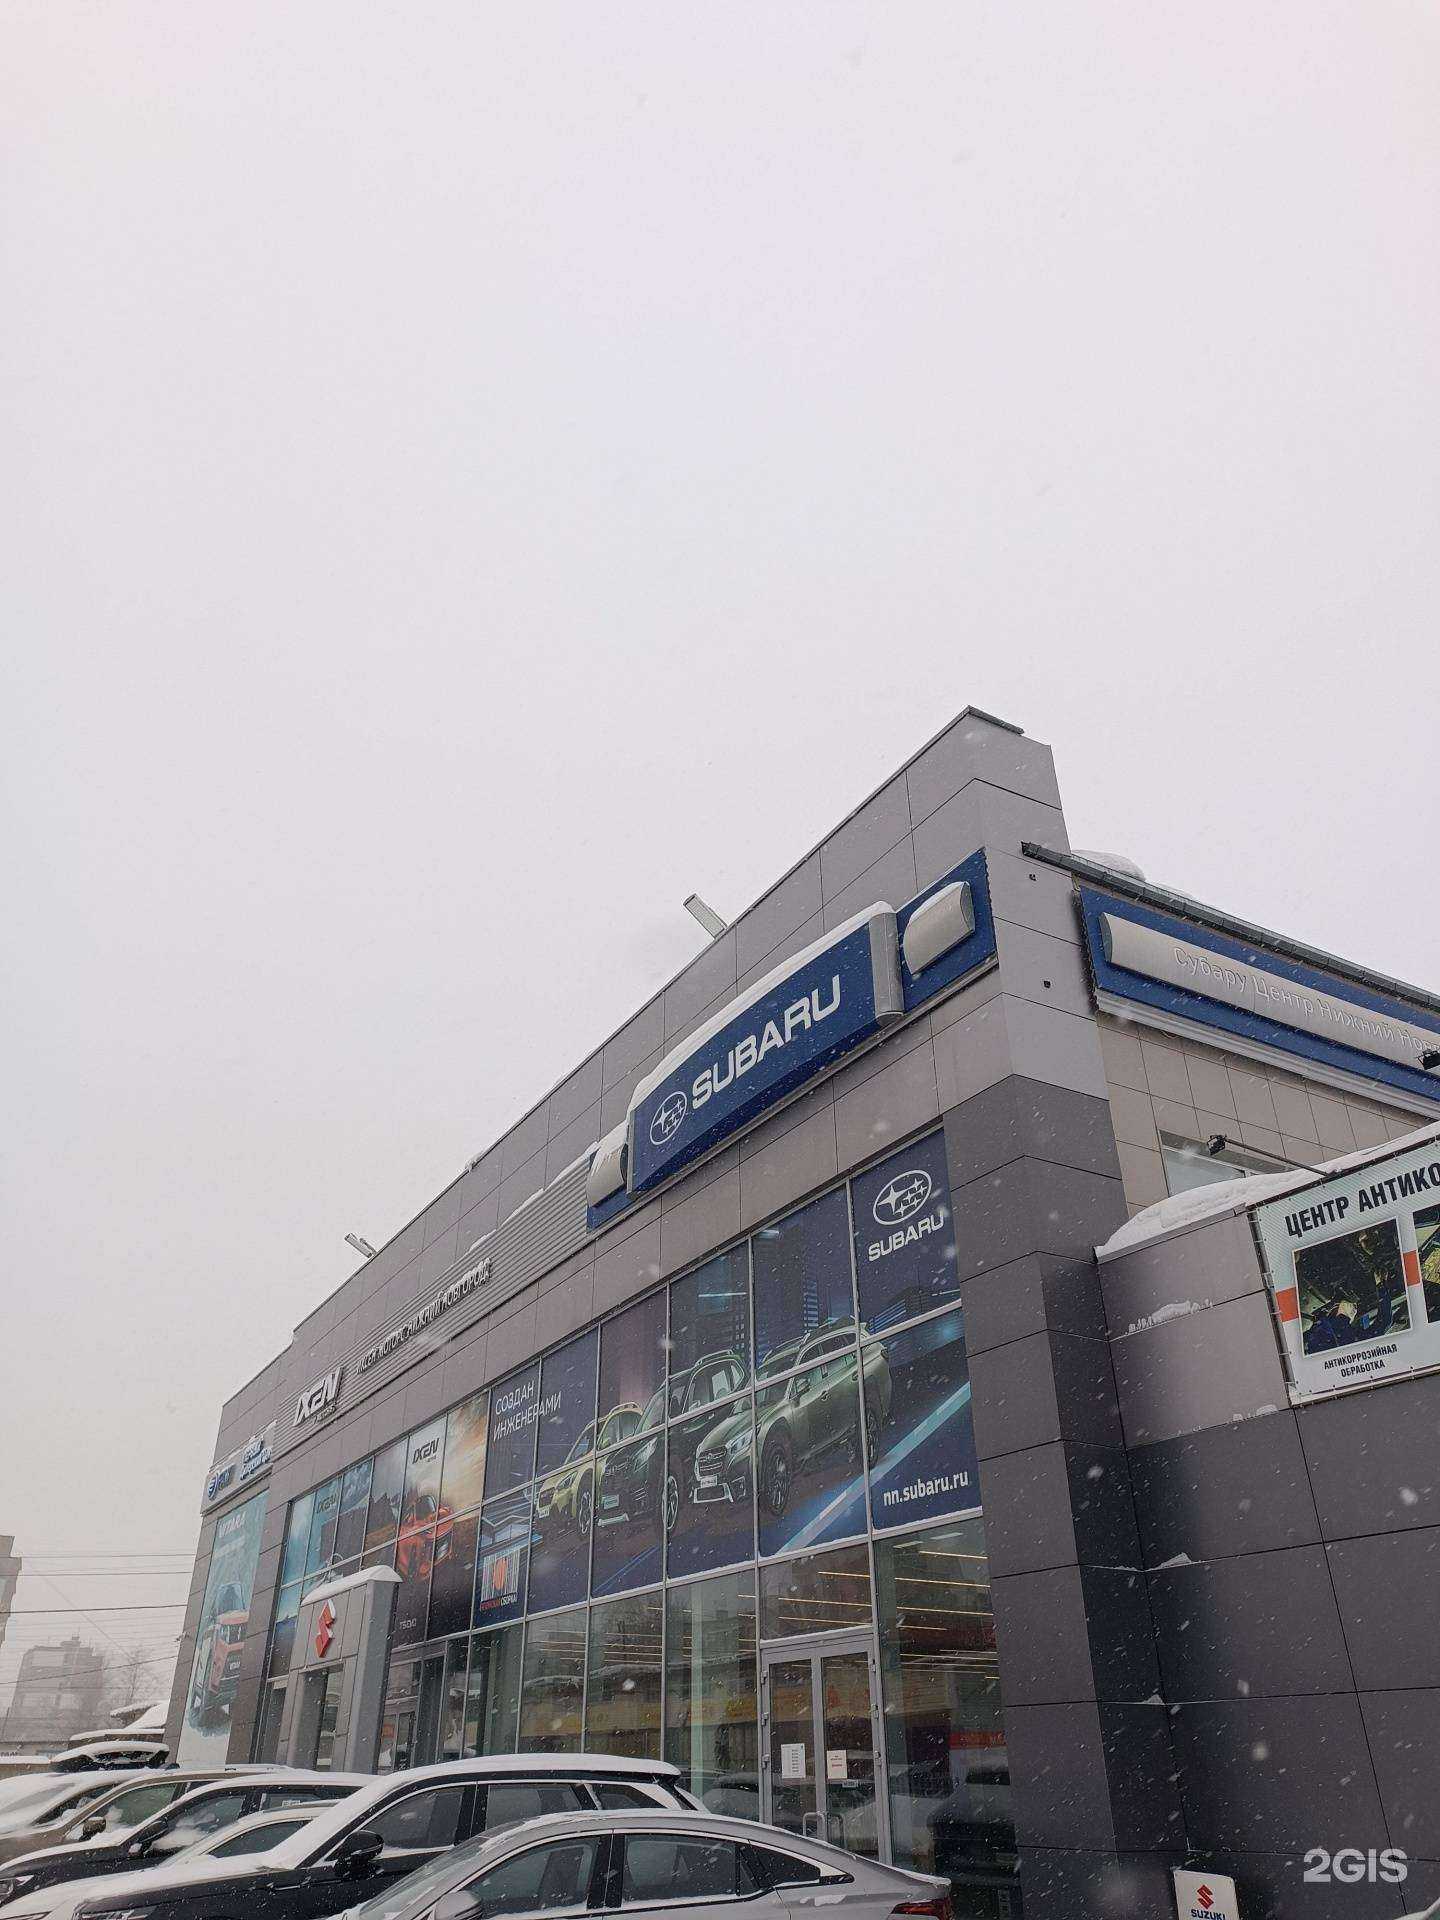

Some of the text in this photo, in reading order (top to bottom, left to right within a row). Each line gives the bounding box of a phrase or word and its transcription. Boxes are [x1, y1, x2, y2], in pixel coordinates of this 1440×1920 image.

[1173, 946, 1248, 993] Субару
[1252, 975, 1314, 1017] Центр
[1319, 1000, 1395, 1041] Нижний
[692, 974, 841, 1110] SUBARU
[1285, 1162, 1440, 1238] ЦЕНТР АНТИКО
[868, 1208, 944, 1262] SUBARU
[1324, 1343, 1398, 1370] АНТИКОРРОЗИЙНАЯ
[1340, 1359, 1386, 1377] ОБРАБОТКА
[493, 1391, 562, 1443] ИНЖЕНЕРАМИ
[495, 1380, 535, 1415] СОЗДАН
[883, 1471, 969, 1506] nn.subaru.ru
[1190, 1909, 1226, 1920] SUZUKI
